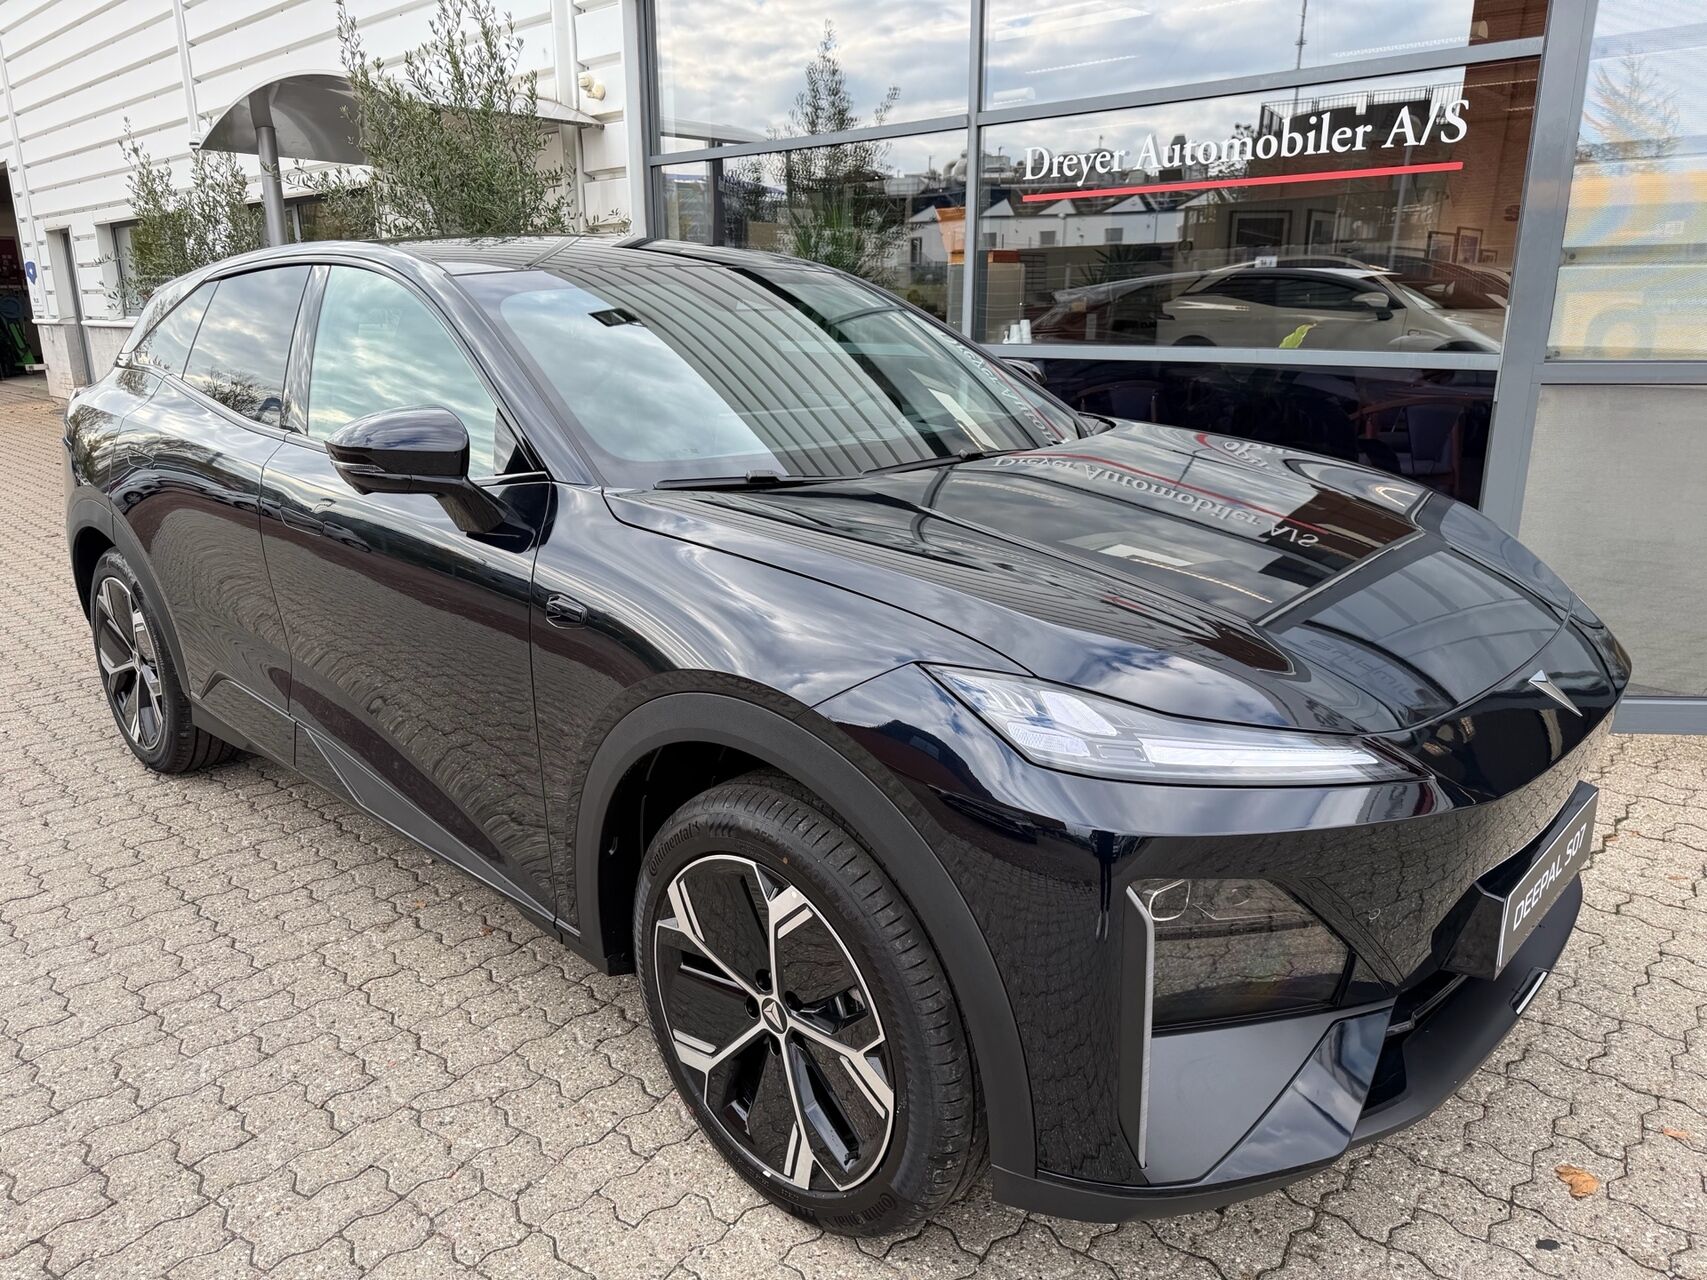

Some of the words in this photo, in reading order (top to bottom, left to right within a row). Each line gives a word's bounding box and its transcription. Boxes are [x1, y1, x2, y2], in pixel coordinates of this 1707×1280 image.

[1023, 146, 1126, 187] Dreyer
[1134, 112, 1373, 171] Automobiler
[1381, 99, 1470, 149] A/S
[649, 822, 694, 877] Continental
[1511, 855, 1563, 932] DEEPAL
[1563, 822, 1588, 866] S07
